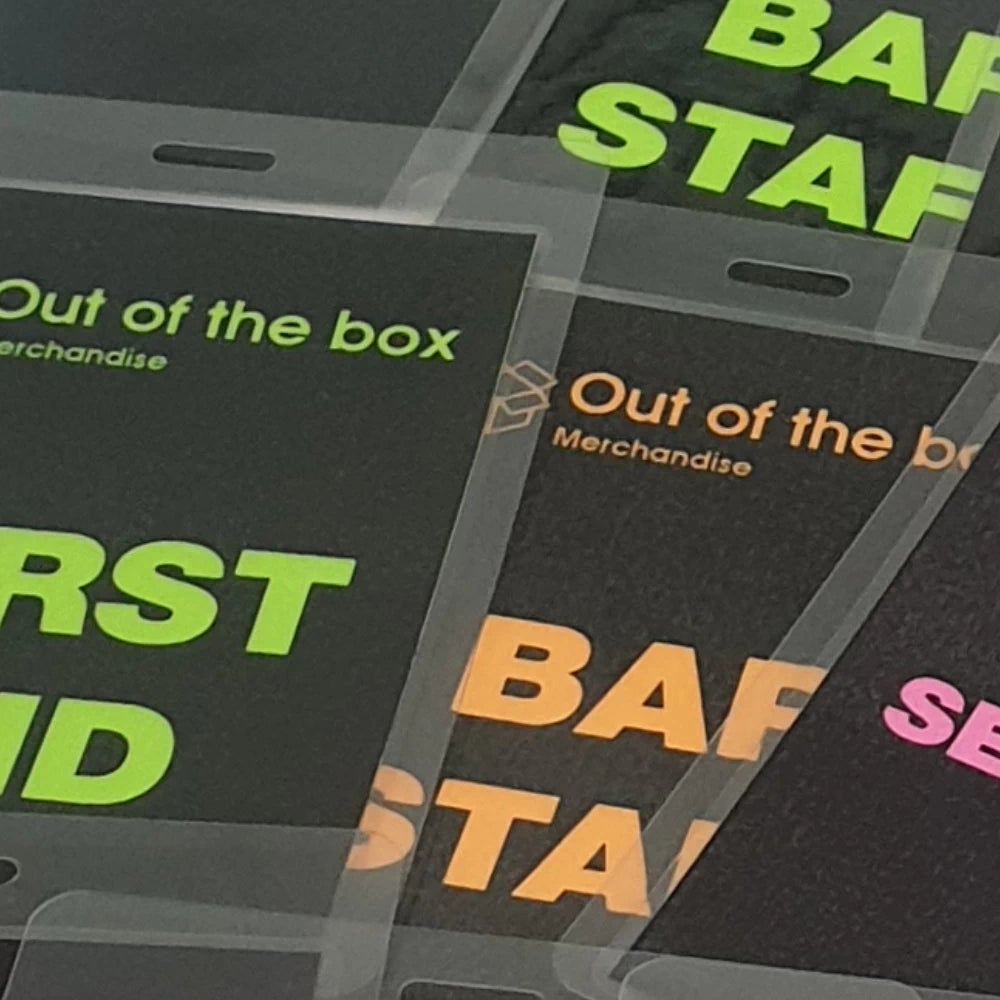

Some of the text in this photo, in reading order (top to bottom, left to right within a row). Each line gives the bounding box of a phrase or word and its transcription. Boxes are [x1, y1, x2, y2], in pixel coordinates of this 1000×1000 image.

[0, 278, 462, 362] Out of the box
[552, 427, 753, 479] Merchandise
[568, 372, 691, 429] Out
[705, 400, 777, 443] of
[789, 408, 893, 463] the
